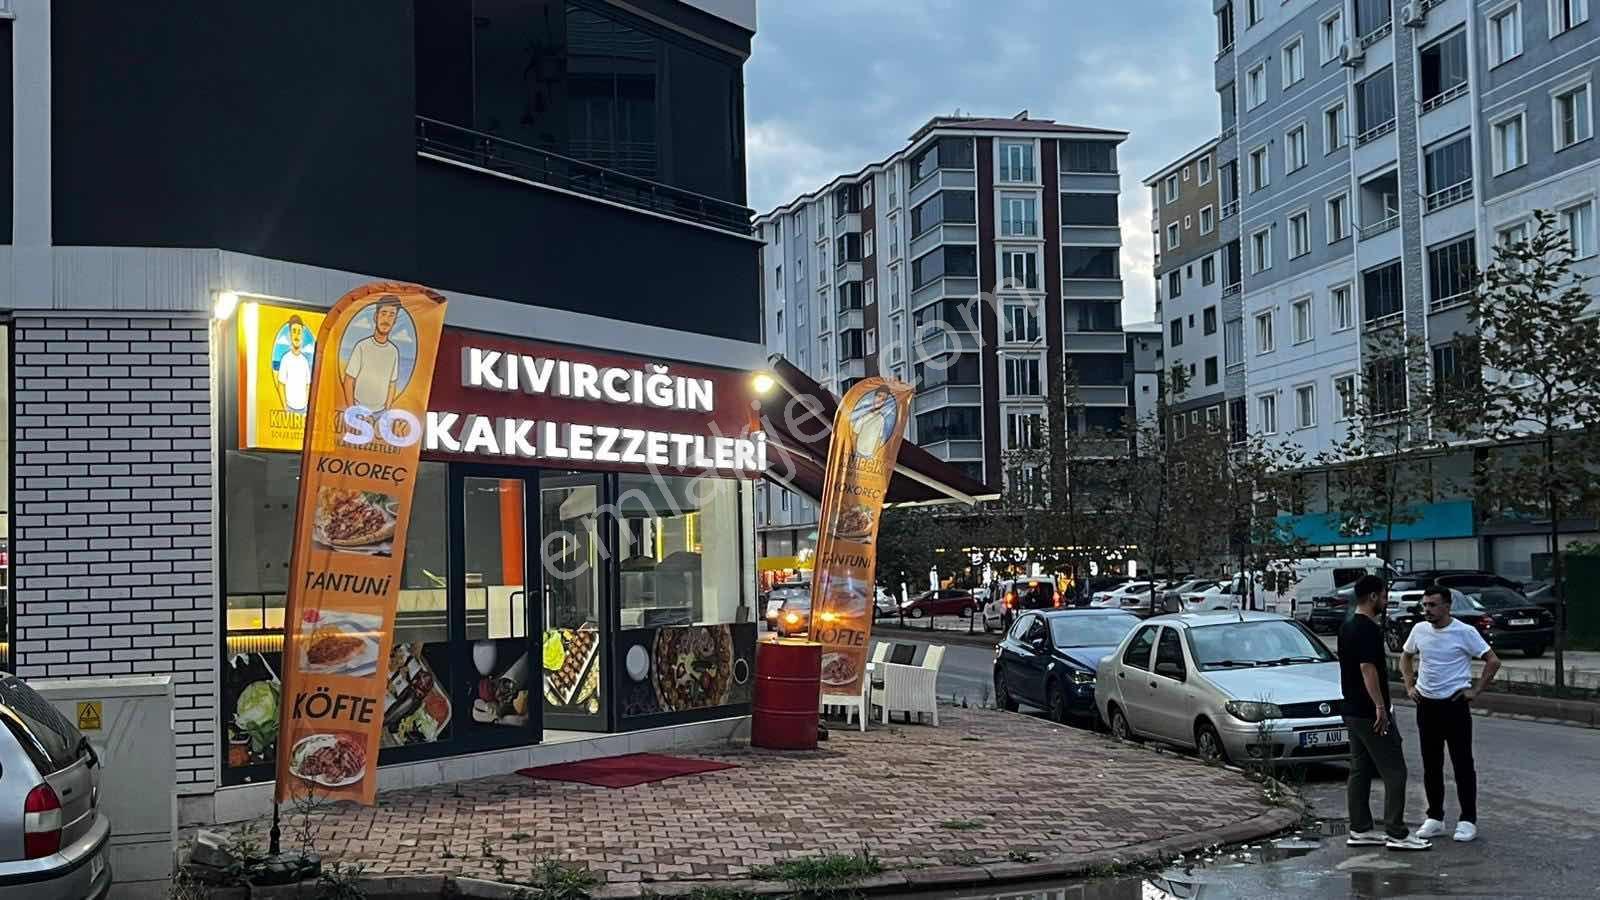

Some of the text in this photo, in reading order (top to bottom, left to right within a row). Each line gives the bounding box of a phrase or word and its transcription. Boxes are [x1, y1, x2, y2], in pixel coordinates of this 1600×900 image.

[462, 346, 713, 412] KIVIRCIĞIN
[543, 421, 767, 472] LEZZETLERİ
[316, 457, 408, 487] KOKOREÇ
[304, 571, 392, 597] TANTUNİ
[292, 686, 377, 724] KÖFTE
[1307, 732, 1319, 744] 55
